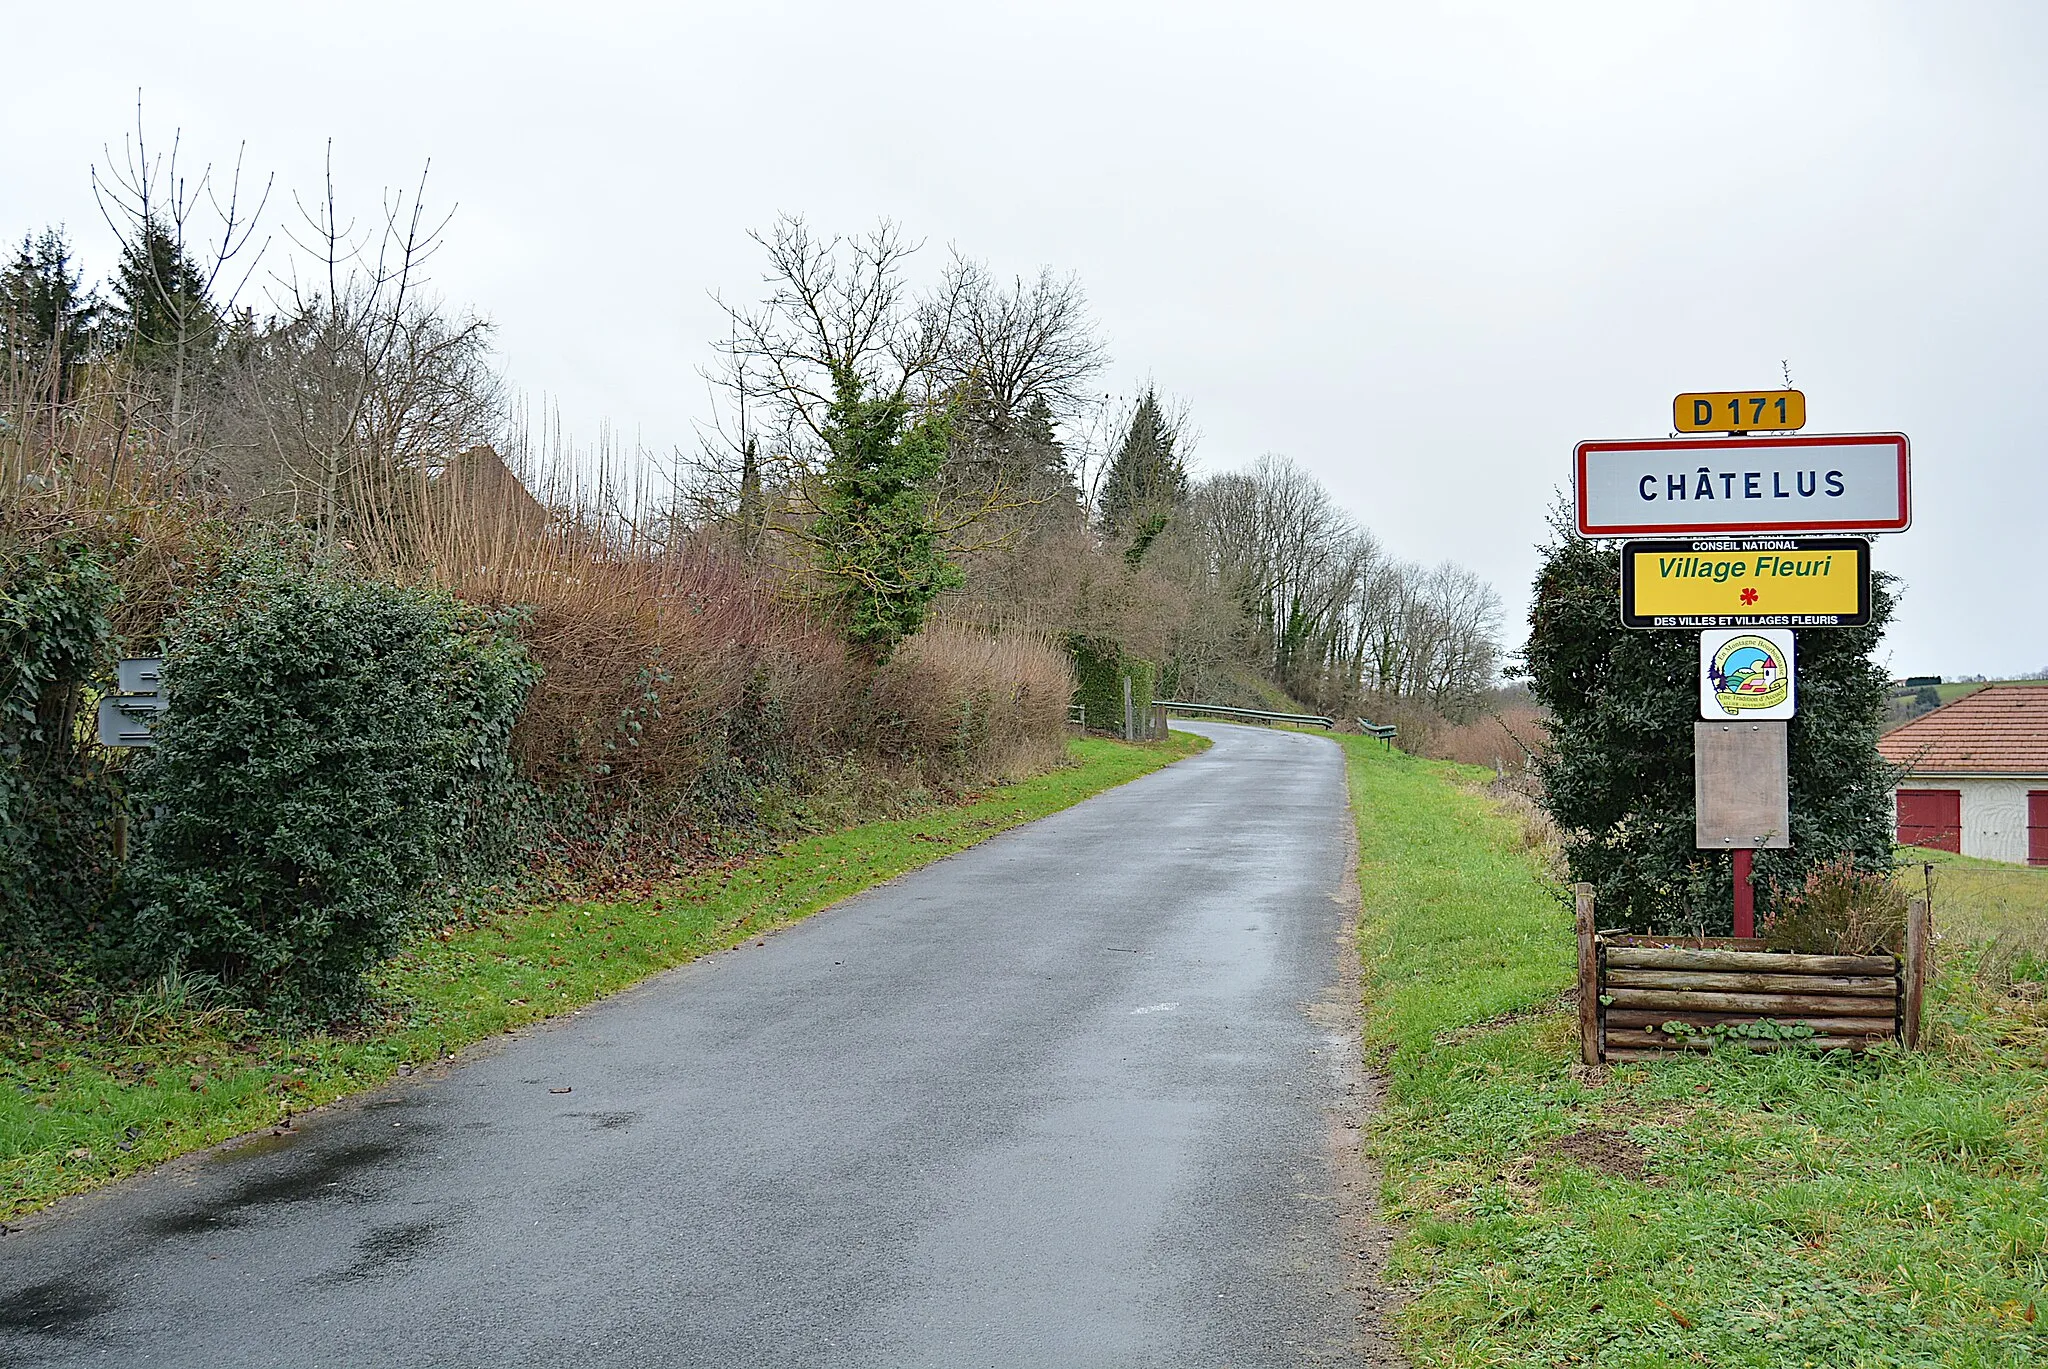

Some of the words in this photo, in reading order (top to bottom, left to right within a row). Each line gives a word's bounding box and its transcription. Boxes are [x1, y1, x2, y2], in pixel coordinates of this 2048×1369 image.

[1693, 400, 1713, 426] D
[1727, 398, 1787, 425] 171
[1639, 467, 1846, 501] CHÂTELUS
[1692, 541, 1740, 551] CONSEIL
[1742, 540, 1798, 551] NATIONAL
[1659, 557, 1746, 583] Village
[1754, 555, 1832, 577] Fleuri
[1654, 616, 1677, 626] DES
[1678, 616, 1717, 626] VILLES
[1718, 616, 1733, 626] ET
[1734, 615, 1790, 626] VILLAGES
[1791, 615, 1838, 625] FLEURIS
[1717, 652, 1726, 661] En
[1725, 640, 1757, 652] Montagne
